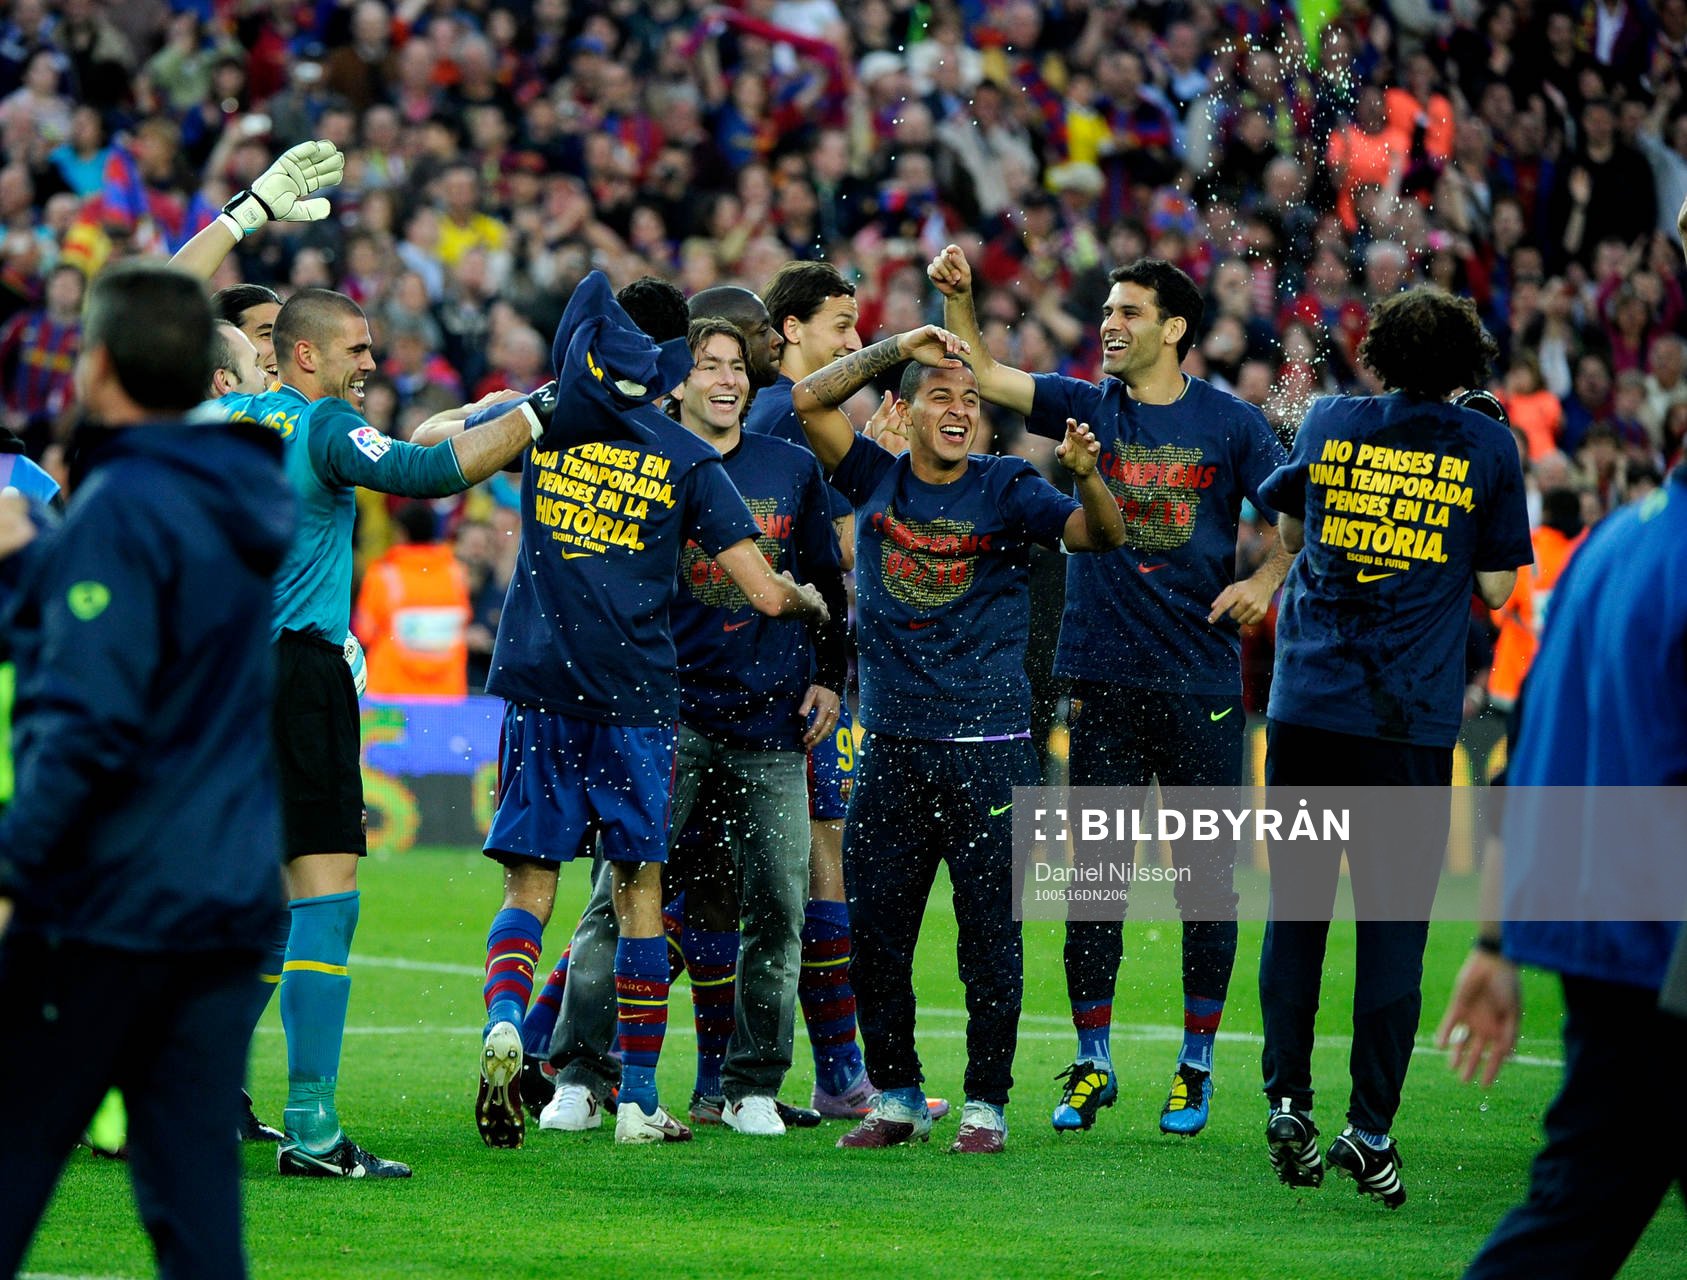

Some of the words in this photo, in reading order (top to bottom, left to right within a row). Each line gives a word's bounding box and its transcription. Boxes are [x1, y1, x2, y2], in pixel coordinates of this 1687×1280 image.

[561, 454, 677, 509] TEMPORADA,
[640, 453, 671, 480] EN
[1101, 452, 1217, 489] CAMPIONS
[1321, 440, 1353, 463] NO
[1355, 444, 1436, 475] PENSES
[1438, 456, 1470, 482] EN
[537, 469, 597, 503] PENSES
[596, 489, 623, 513] EN
[624, 497, 649, 520] LA
[1309, 463, 1345, 487] UNA
[1351, 468, 1476, 513] TEMPORADA,
[1325, 488, 1390, 517] PENSES
[1393, 499, 1422, 522] EN
[1424, 503, 1450, 527] LA
[536, 495, 645, 551] HISTÒRIA.
[552, 531, 574, 544] ESCRIU
[582, 536, 606, 554] FUTUR
[1320, 515, 1448, 563] HISTÒRIA.
[886, 551, 968, 586] 09/10
[1346, 552, 1373, 565] ESCRIU
[1375, 557, 1384, 566] EL
[1384, 558, 1410, 571] FUTUR
[836, 727, 854, 772] 9
